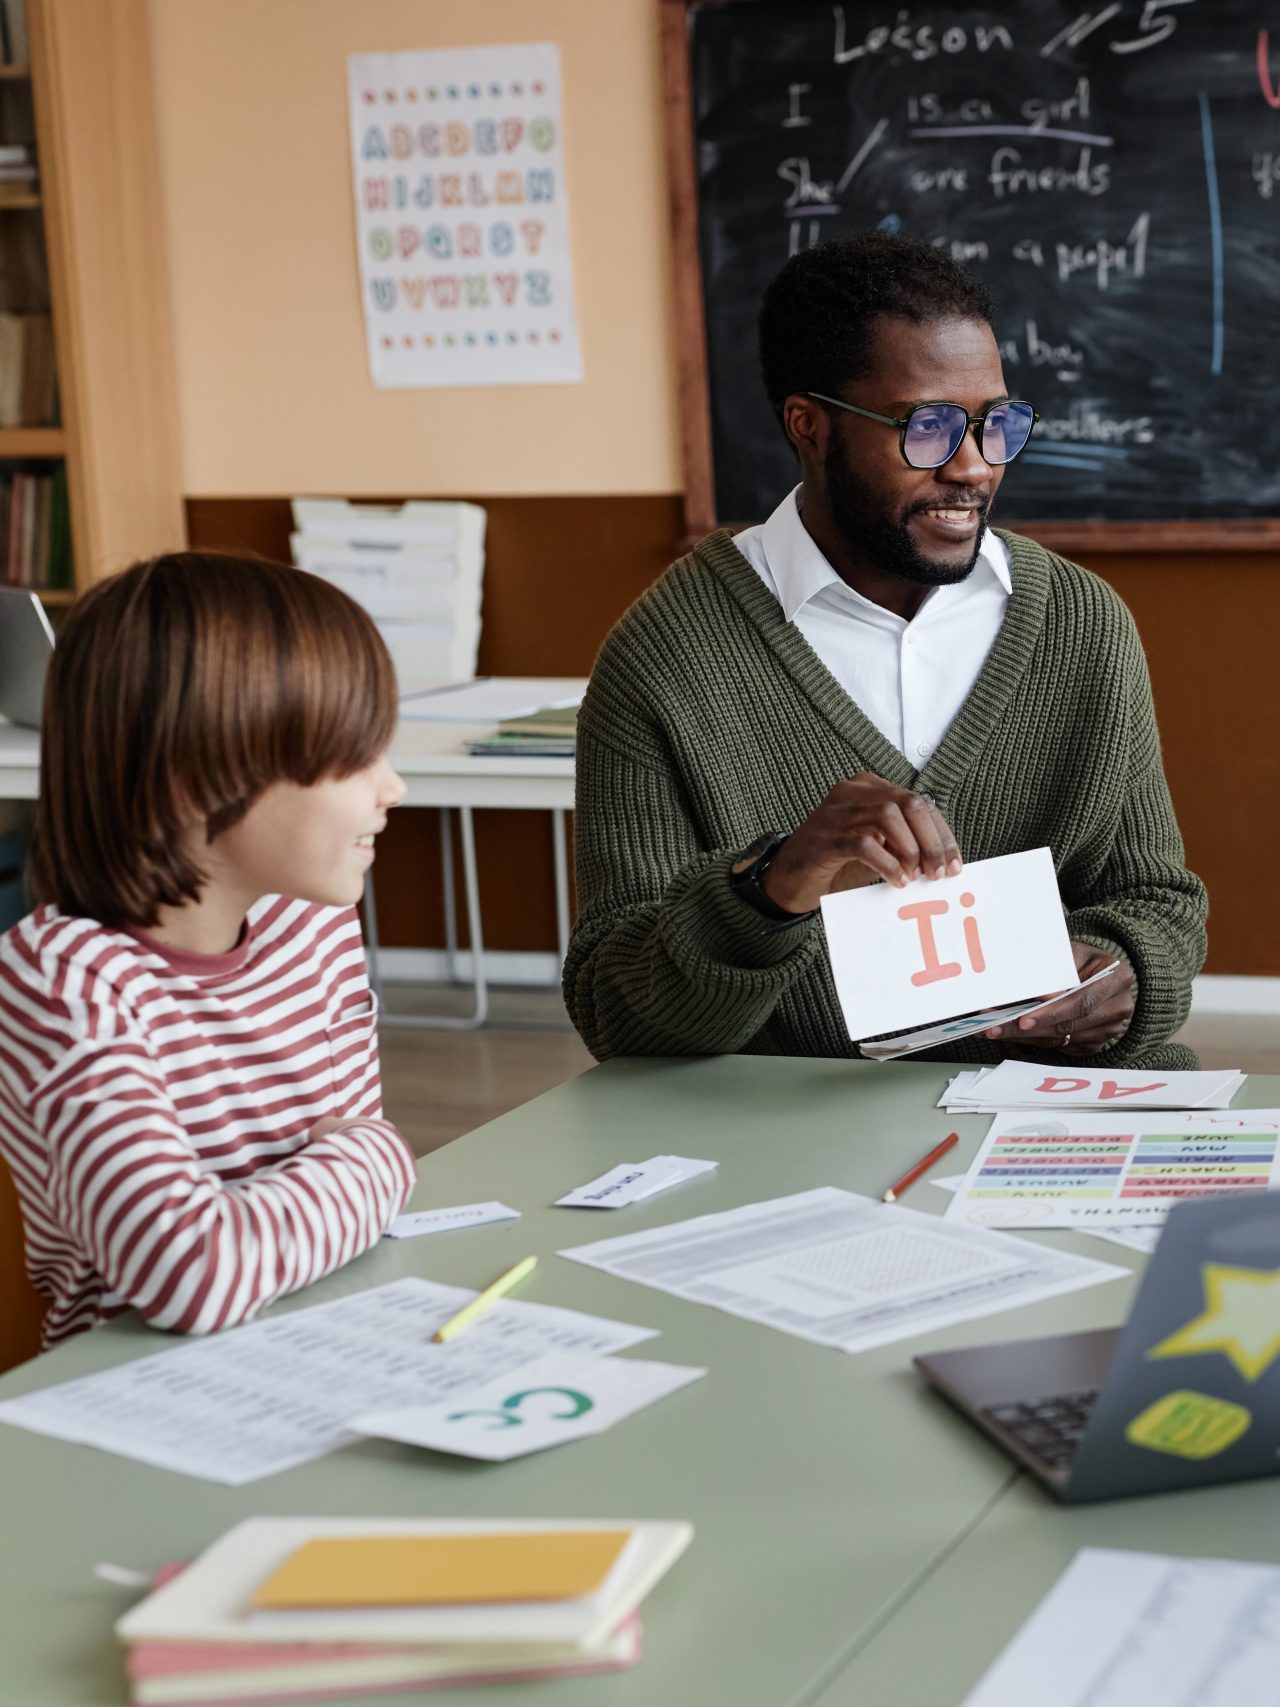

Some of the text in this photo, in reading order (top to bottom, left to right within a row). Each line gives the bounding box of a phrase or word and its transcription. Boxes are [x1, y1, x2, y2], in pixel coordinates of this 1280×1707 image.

[834, 5, 1013, 63] Lesson
[1109, 0, 1196, 54] 5
[1020, 76, 1090, 133] girl
[988, 146, 1110, 199] friends
[897, 891, 986, 987] Ii
[1009, 1135, 1121, 1143] DECEMBER
[1181, 1134, 1235, 1142] JUNE
[1002, 1145, 1120, 1153] NOVEMBER
[1007, 1156, 1106, 1164] OCTOBER
[1175, 1155, 1235, 1163] APRIL
[985, 1167, 1112, 1176] SEPTEMBER
[1160, 1166, 1236, 1174] MARCH
[1003, 1179, 1089, 1187] AUGUST
[1137, 1177, 1256, 1186] FEBRUARY
[1011, 1190, 1070, 1198] JULY
